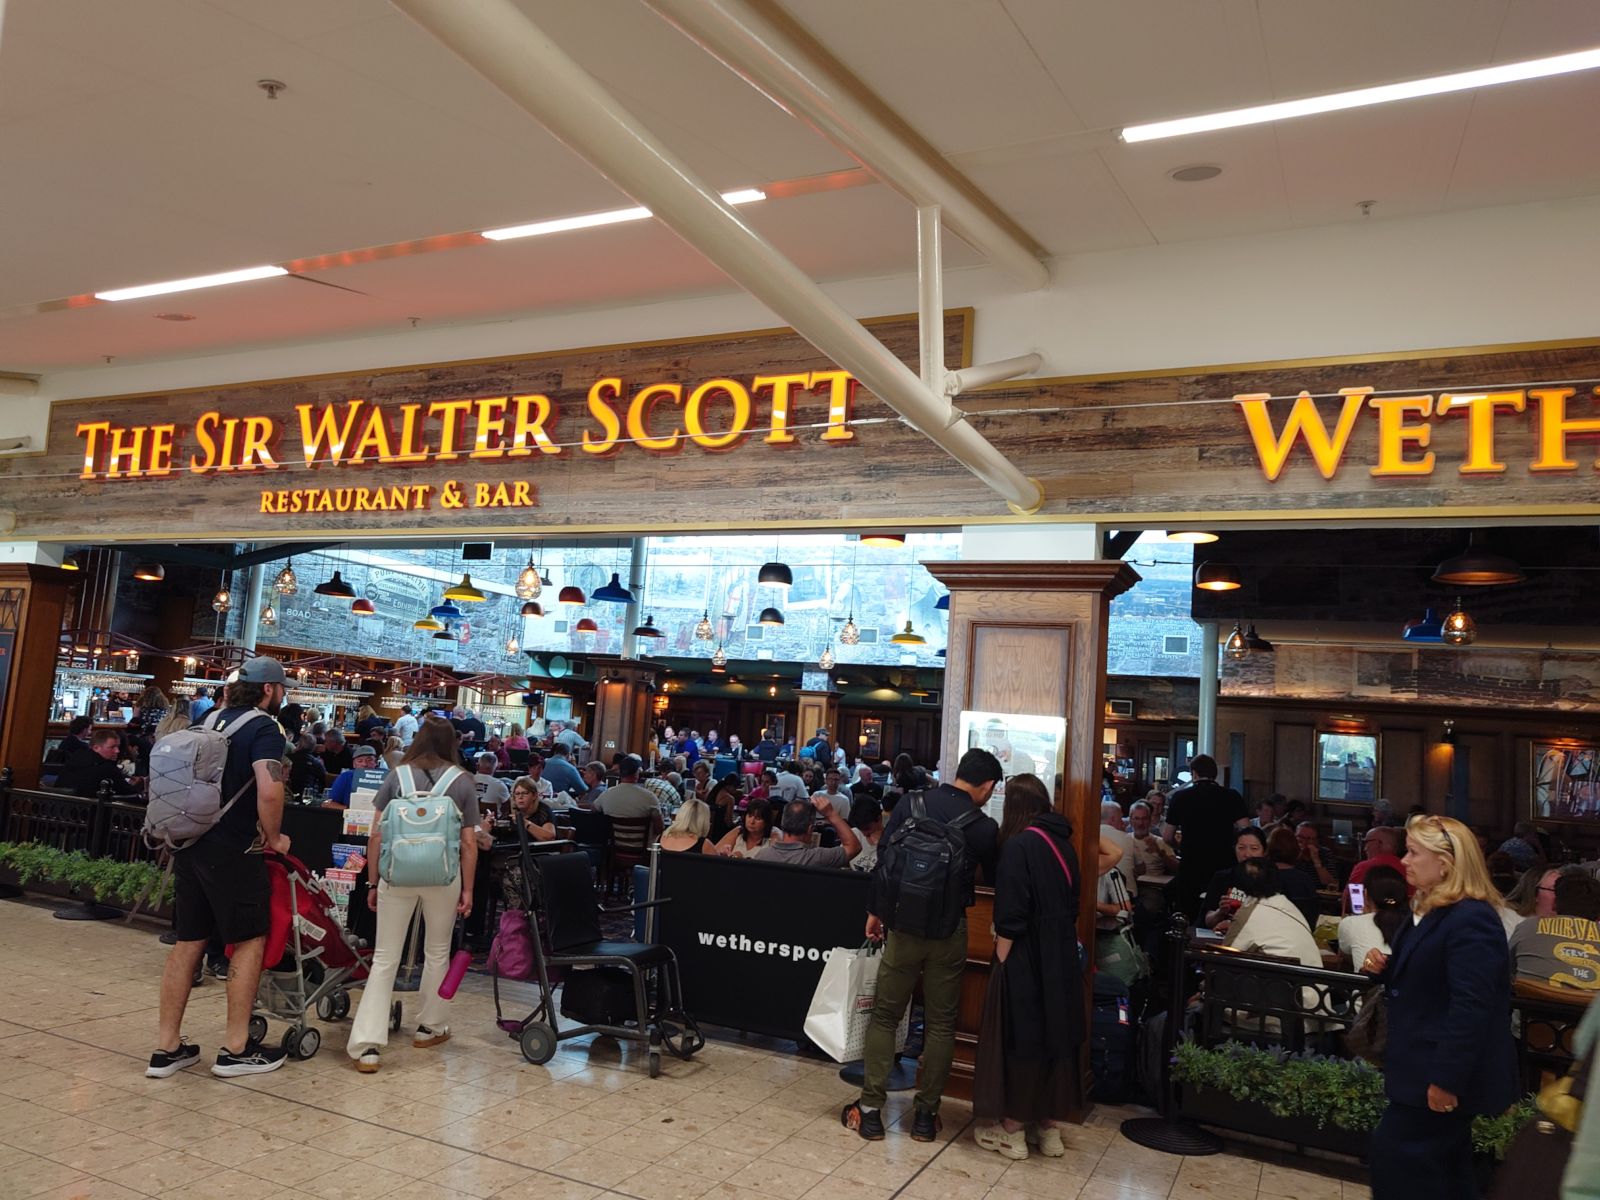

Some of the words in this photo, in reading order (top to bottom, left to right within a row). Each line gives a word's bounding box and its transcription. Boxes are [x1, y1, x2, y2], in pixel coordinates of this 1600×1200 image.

[76, 421, 175, 479] THE
[189, 411, 280, 474] SIR
[295, 393, 563, 469] WALTER
[582, 371, 855, 454] SCOTT
[1232, 384, 1600, 481] WETH
[259, 484, 431, 514] RESTAURANT
[440, 479, 464, 509] &
[474, 480, 535, 508] BAR
[698, 931, 833, 962] wetherspoo
[1572, 967, 1589, 978] THE
